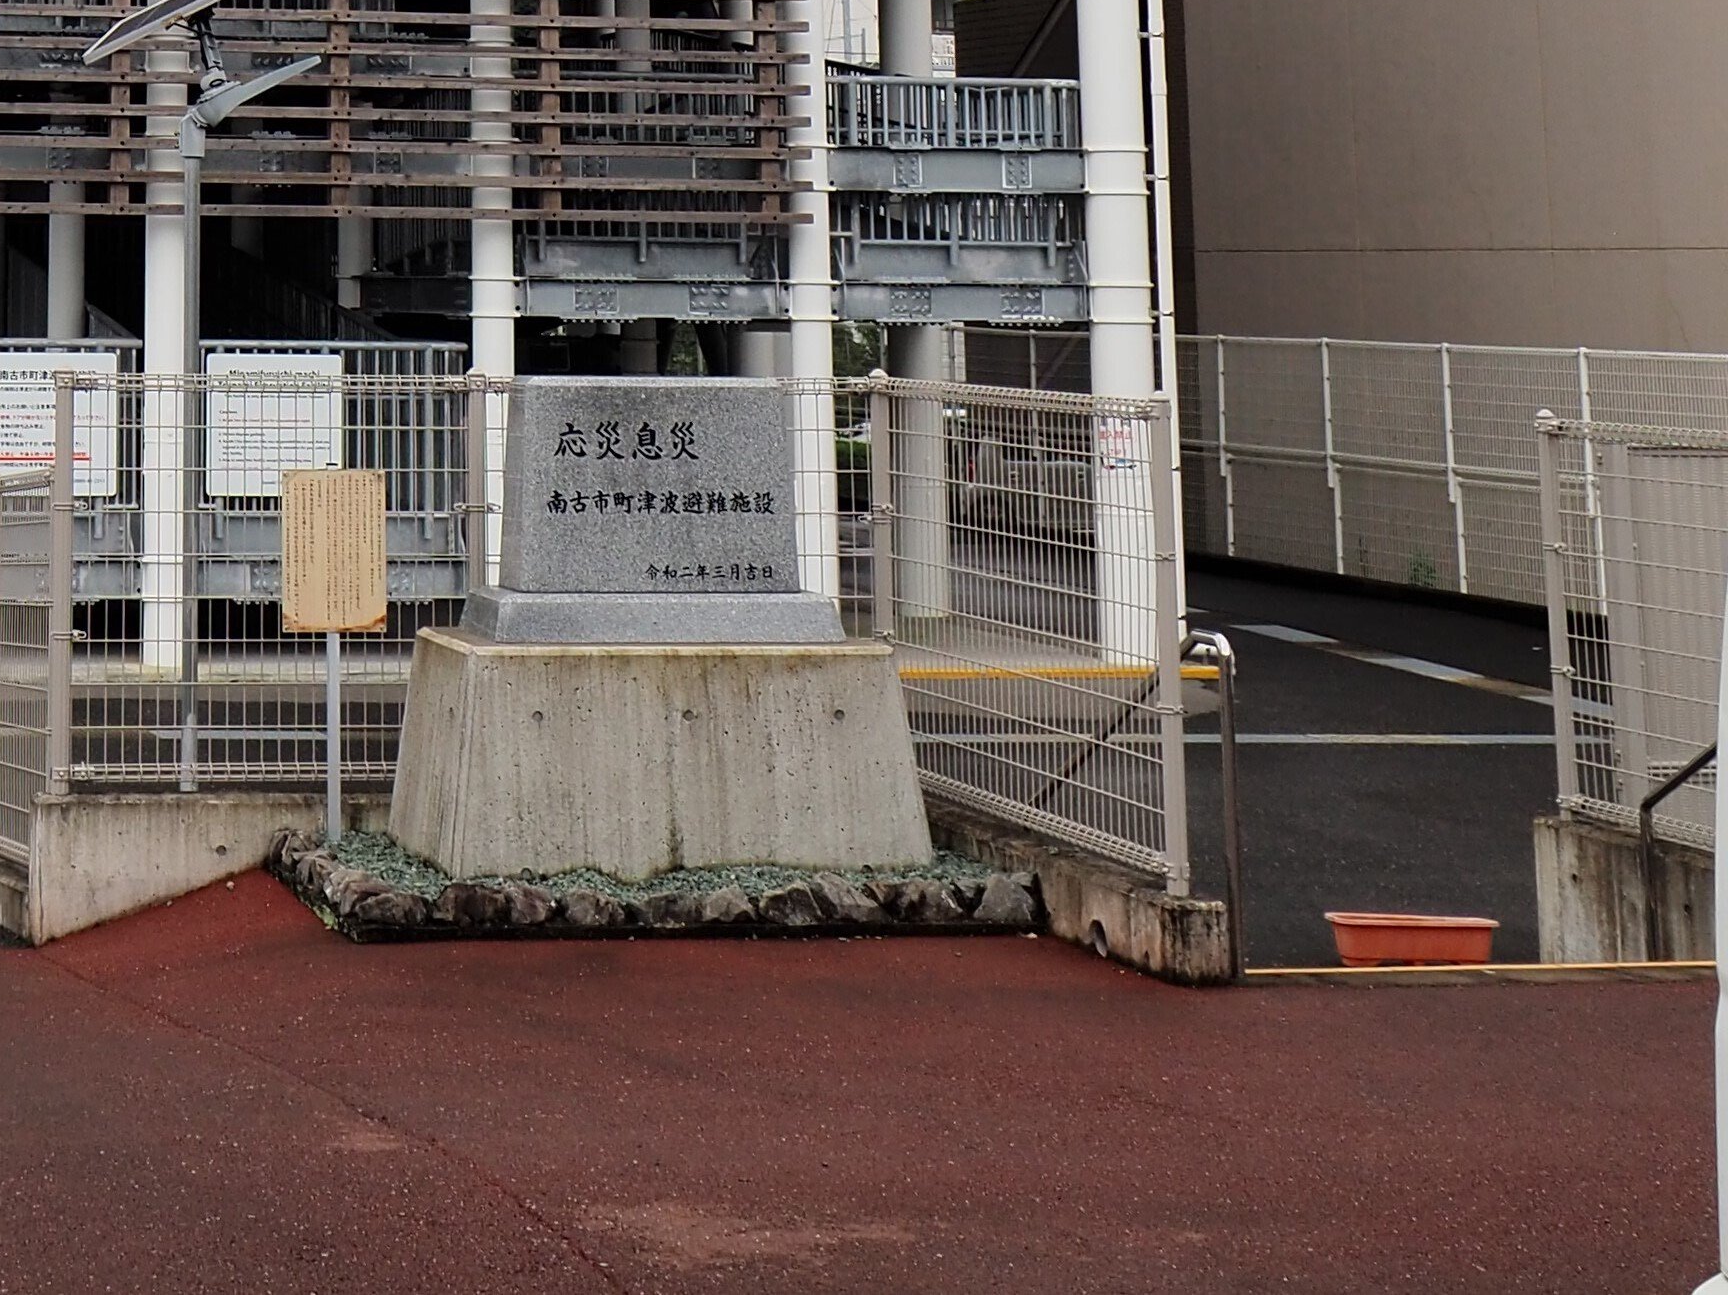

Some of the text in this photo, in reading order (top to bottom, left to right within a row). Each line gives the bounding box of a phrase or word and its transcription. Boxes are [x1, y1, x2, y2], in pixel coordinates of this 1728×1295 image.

[546, 490, 776, 515] 南古市町津波避難施設
[645, 563, 774, 581] 令和二年三月吉日
